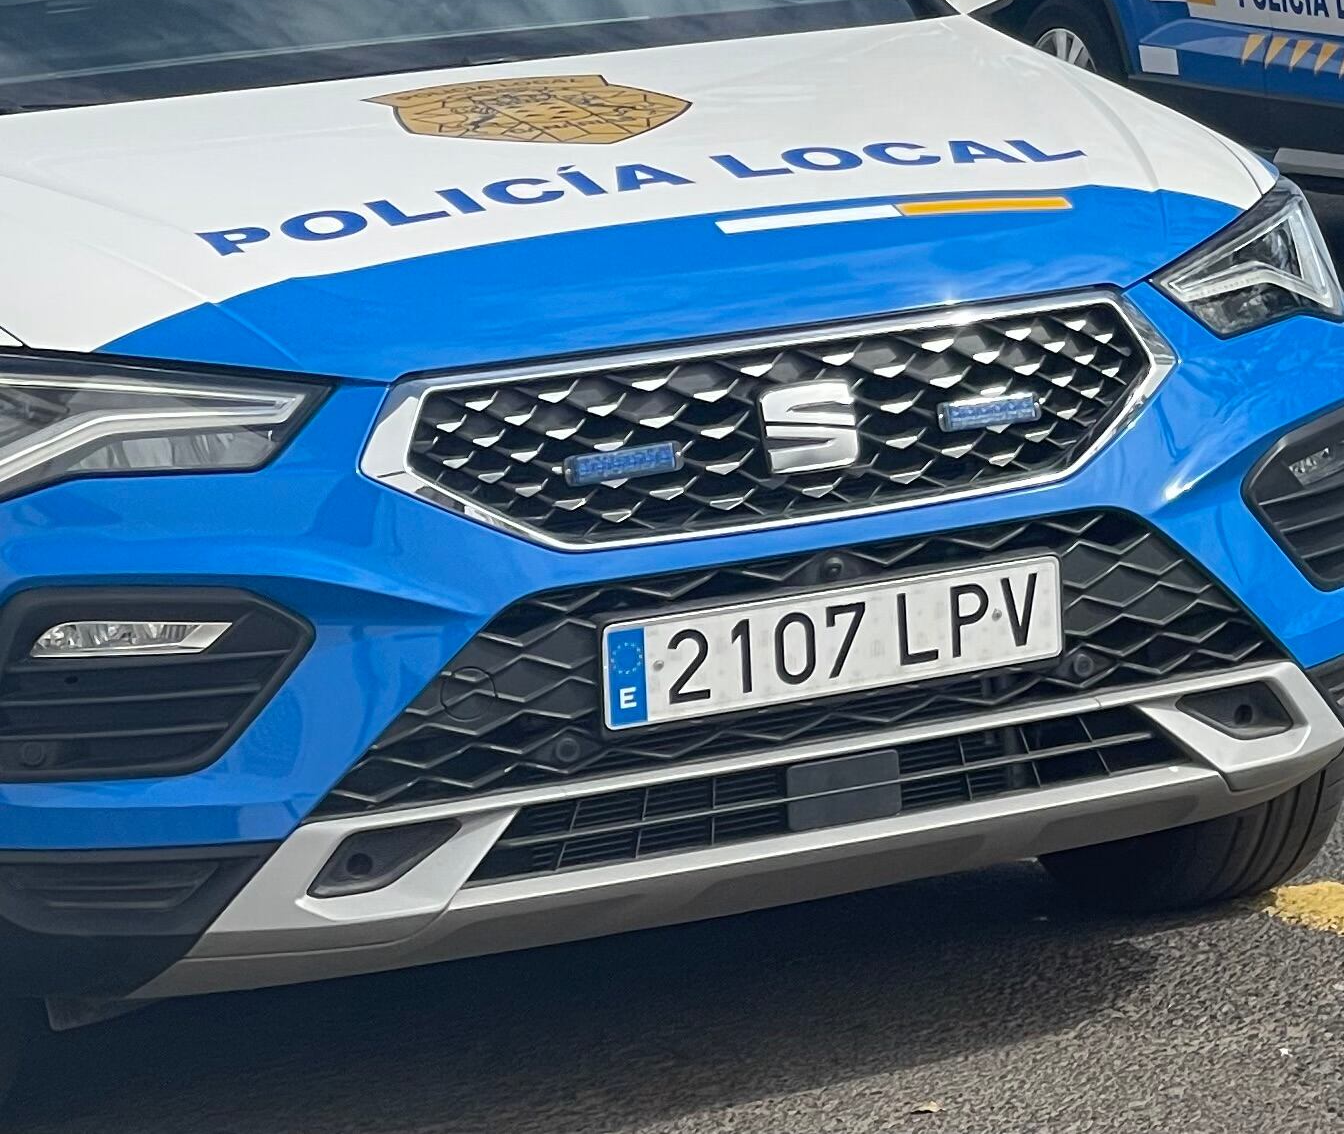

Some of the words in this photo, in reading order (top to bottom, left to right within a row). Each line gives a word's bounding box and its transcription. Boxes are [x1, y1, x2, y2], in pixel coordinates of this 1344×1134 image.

[195, 164, 695, 256] POLICÍA
[709, 138, 1087, 179] LOCAL
[619, 686, 637, 709] E
[666, 602, 866, 705] 2107
[897, 572, 1038, 667] LPV
